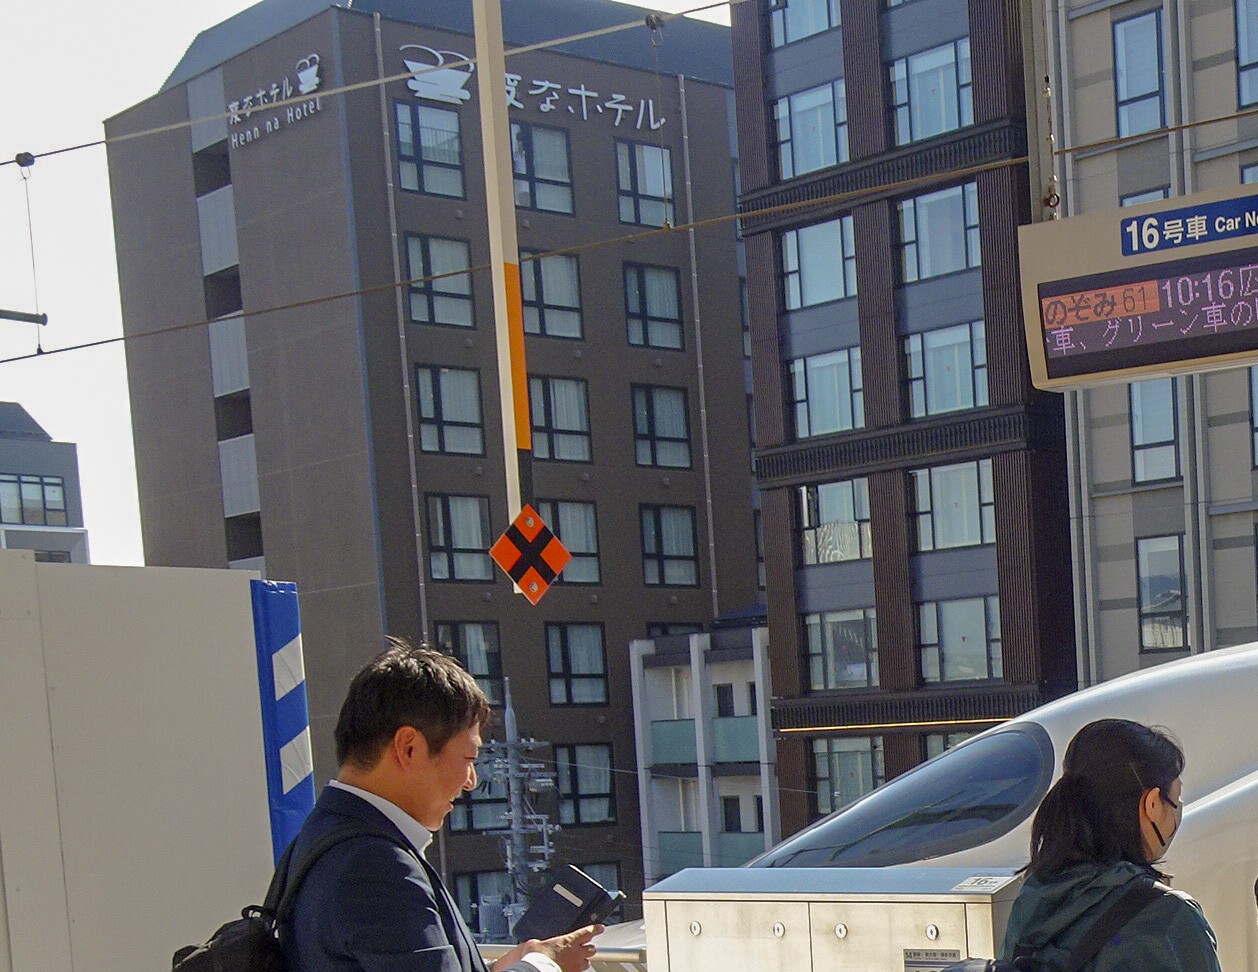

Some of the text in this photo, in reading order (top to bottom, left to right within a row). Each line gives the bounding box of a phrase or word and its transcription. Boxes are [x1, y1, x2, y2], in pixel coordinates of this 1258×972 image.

[231, 97, 320, 149] Henn na Hotel
[1126, 215, 1208, 251] 16号車
[1215, 215, 1241, 233] Car
[1162, 269, 1235, 308] 10:16
